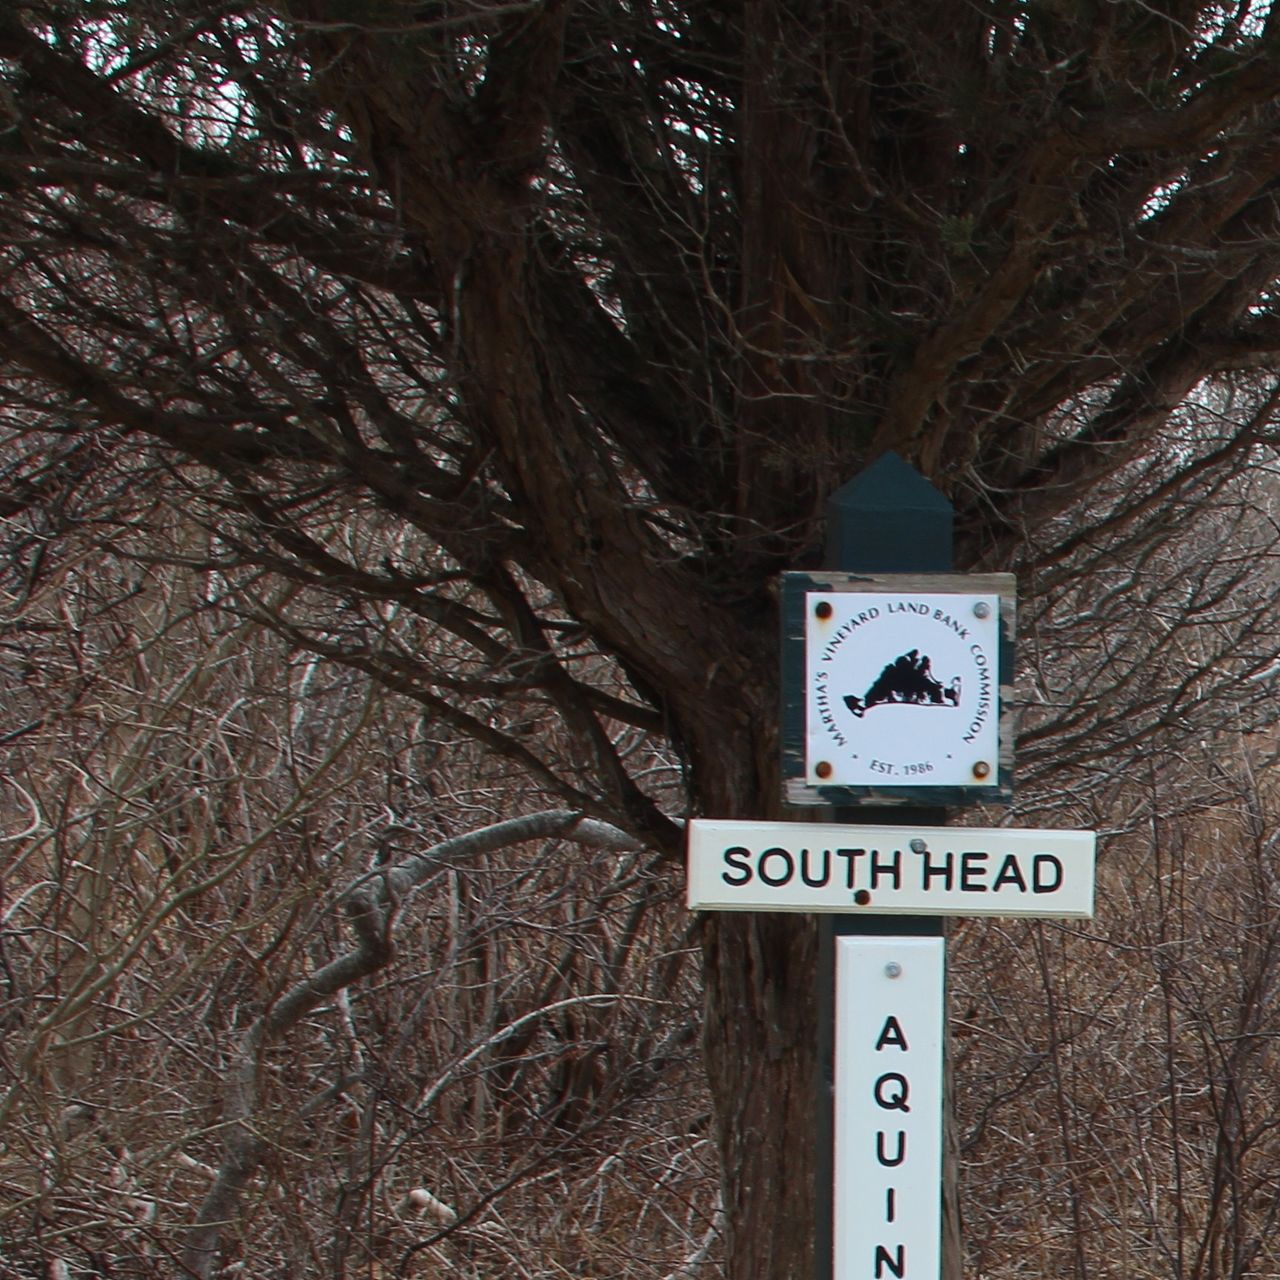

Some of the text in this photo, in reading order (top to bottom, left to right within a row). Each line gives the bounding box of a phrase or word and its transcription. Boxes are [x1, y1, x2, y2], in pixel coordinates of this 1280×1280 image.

[814, 602, 991, 747] MARTHA'S VINEYARD LAND BANK COMMISSION
[869, 759, 934, 776] EST. 1986
[721, 846, 1063, 894] SOUTH HEAD
